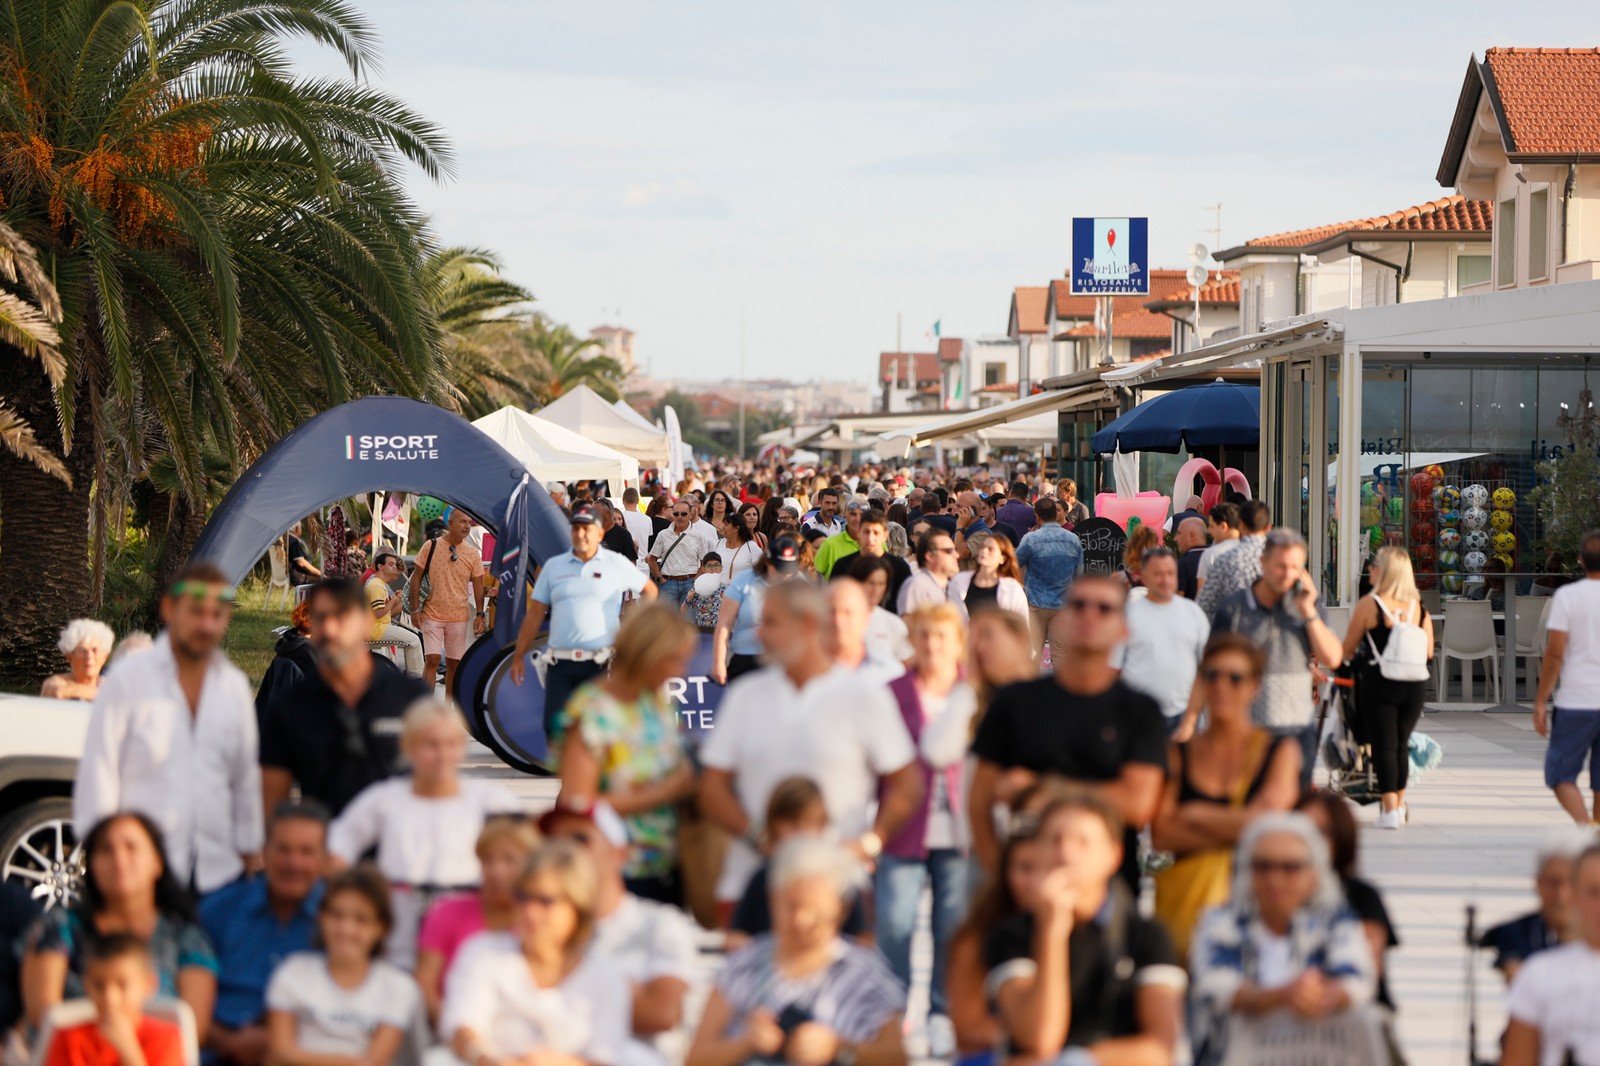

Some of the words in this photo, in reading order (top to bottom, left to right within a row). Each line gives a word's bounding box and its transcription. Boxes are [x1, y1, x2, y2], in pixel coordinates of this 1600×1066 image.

[1081, 257, 1141, 275] Marilena
[1077, 278, 1142, 286] RISTORANTE
[359, 435, 438, 449] SPORT
[359, 450, 369, 460] E
[375, 449, 439, 460] SALUTE
[664, 675, 709, 704] RT
[675, 709, 715, 729] TE
